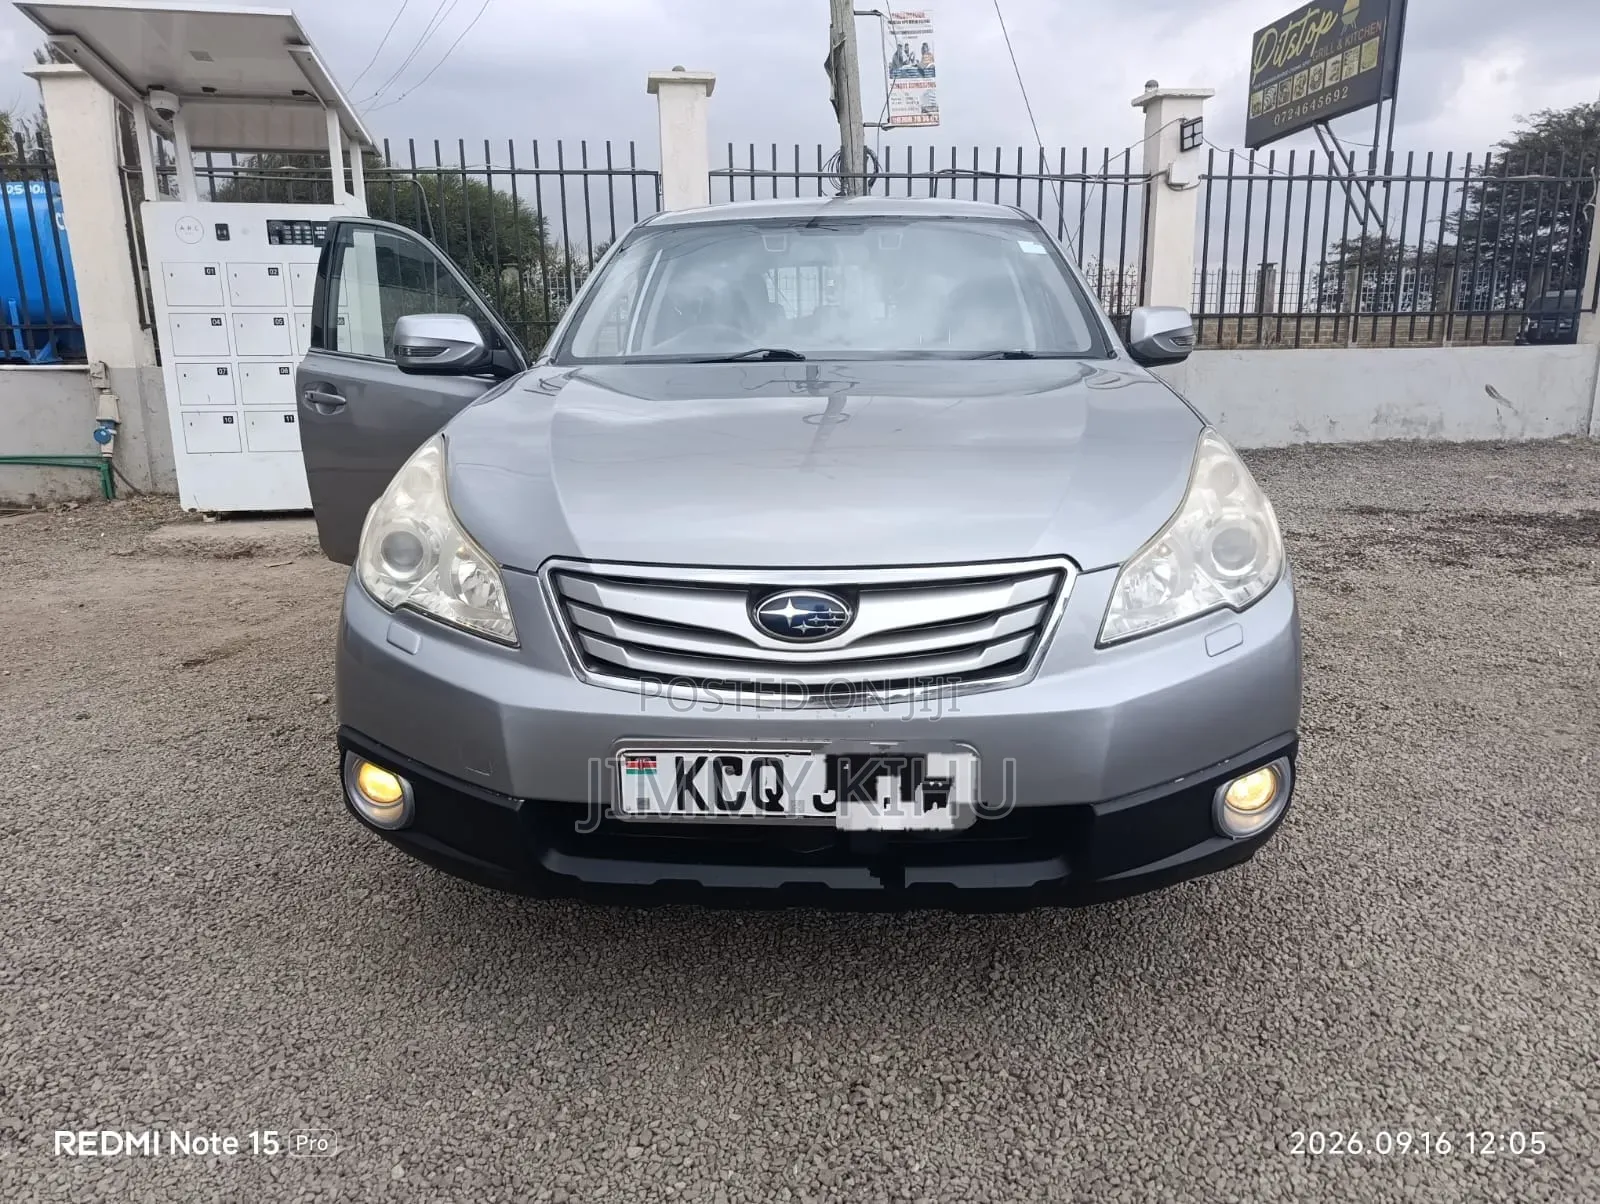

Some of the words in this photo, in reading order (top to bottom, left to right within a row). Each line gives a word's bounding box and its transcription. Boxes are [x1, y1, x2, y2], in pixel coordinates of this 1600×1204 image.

[1252, 8, 1338, 84] Pitstop
[1313, 41, 1334, 61] GRILL
[1344, 20, 1383, 46] KITCHEN
[1274, 87, 1348, 125] 0724645692
[674, 756, 786, 813] KCQ
